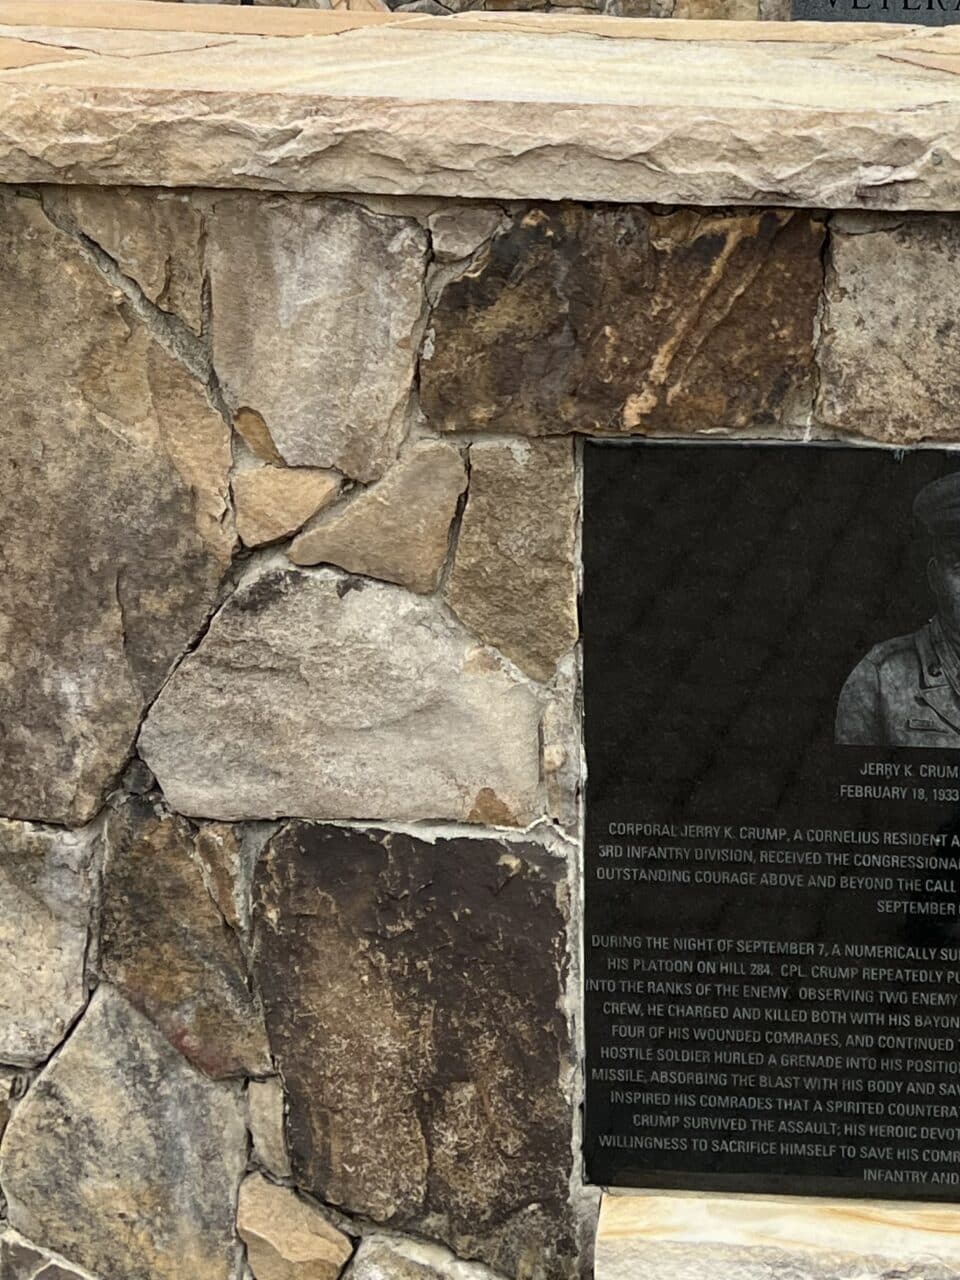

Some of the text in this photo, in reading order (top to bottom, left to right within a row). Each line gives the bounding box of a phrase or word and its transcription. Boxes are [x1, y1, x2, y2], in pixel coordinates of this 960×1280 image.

[859, 761, 900, 776] JERRY
[840, 783, 907, 799] FEBRUARY
[932, 787, 959, 801] 1933
[608, 821, 675, 837] CORPORAL
[680, 823, 720, 838] JERRY
[806, 828, 879, 844] CORNELIUS
[883, 831, 947, 847] RESIDENT
[598, 843, 622, 857] 3RD
[626, 844, 690, 860] INFANTRY
[759, 849, 822, 865] RECEIVED
[596, 866, 690, 883] OUTSTANDING
[694, 869, 755, 885] COURAGE
[759, 872, 803, 887] ABOVE
[839, 875, 893, 890] BEYOND
[925, 878, 955, 893] CALL
[876, 898, 955, 915] SEPTEMBER
[591, 932, 641, 948] DURING
[673, 936, 714, 951] NIGHT
[736, 938, 814, 955] SEPTEMBER
[844, 943, 936, 960] NUMERICALLY
[633, 957, 693, 973] PLATOON
[719, 960, 746, 975] HILL
[810, 964, 858, 979] CRUMP
[862, 966, 943, 983] REPEATEDLY
[647, 979, 692, 995] RANKS
[798, 986, 873, 1002] OBSERVING
[911, 990, 957, 1006] ENEMY
[667, 1003, 728, 1019] CHARGED
[764, 1007, 807, 1022] KILLED
[611, 1023, 645, 1038] FOUR
[692, 1026, 761, 1043] WOUNDED
[877, 1034, 954, 1051] CONTINUED
[600, 1045, 652, 1060] HOSTILE
[656, 1047, 710, 1063] SOLDIER
[714, 1049, 764, 1065] HURLED
[780, 1052, 842, 1068] GRENADE
[650, 1069, 727, 1086] ABSORBING
[758, 1073, 800, 1089] BLAST
[867, 1078, 902, 1093] BODY
[610, 1089, 670, 1105] INSPIRED
[699, 1093, 772, 1110] COMRADES
[825, 1098, 884, 1115] SPIRITED
[632, 1113, 680, 1128] CRUMP
[683, 1115, 746, 1131] SURVIVED
[868, 1123, 917, 1139] HEROIC
[598, 1133, 687, 1150] WILLINGNESS
[711, 1138, 776, 1154] SACRIFICE
[779, 1141, 836, 1157] HIMSELF
[859, 1145, 893, 1160] SAVE
[863, 1167, 927, 1184] INFANTRY
[930, 1170, 959, 1185] AND
